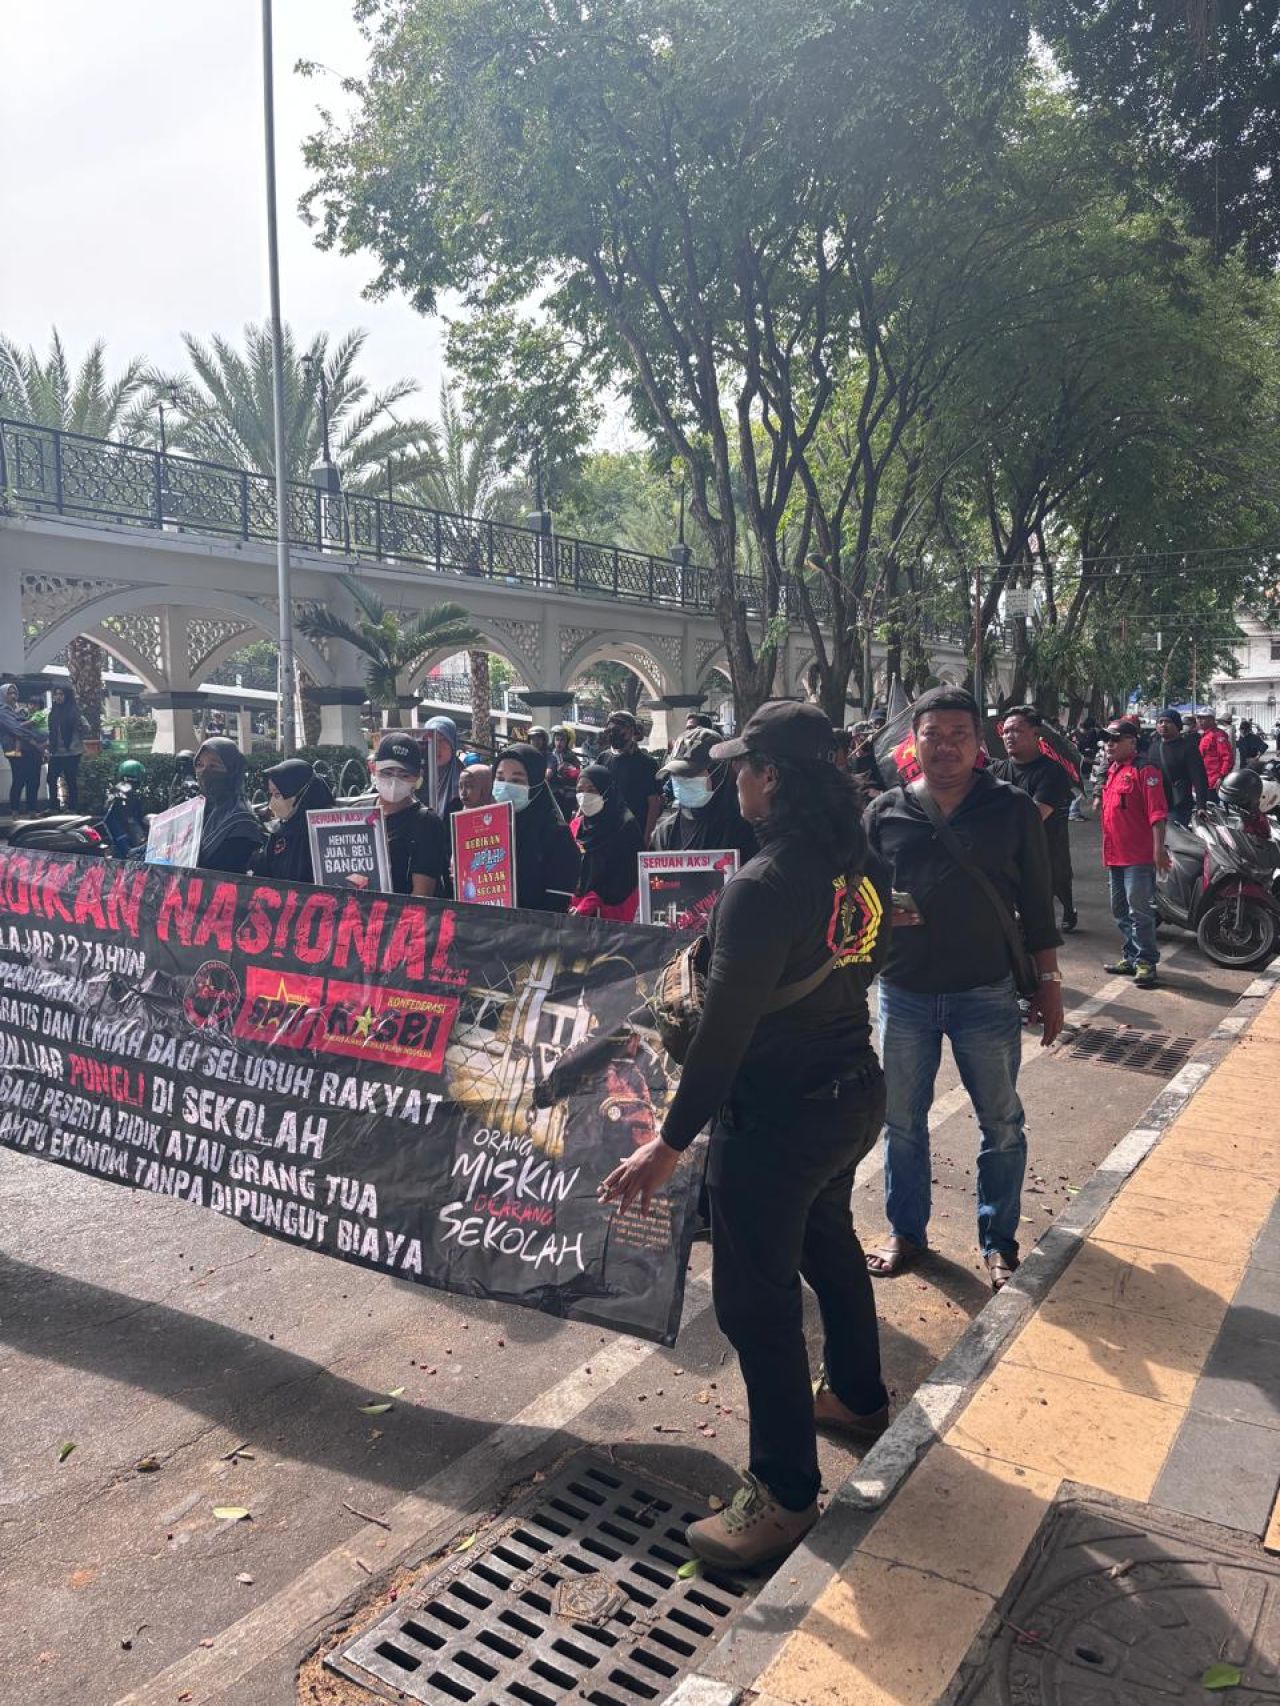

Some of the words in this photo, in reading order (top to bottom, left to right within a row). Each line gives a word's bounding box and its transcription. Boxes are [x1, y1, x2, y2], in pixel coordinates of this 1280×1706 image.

[324, 847, 350, 858] JUAL
[328, 833, 369, 846] HENTIKAN
[643, 856, 683, 868] SERUAN
[687, 856, 710, 867] AKSI
[324, 857, 374, 873] BANGKU
[60, 933, 80, 962] 12
[82, 941, 146, 978] TAHUN
[42, 1006, 76, 1043] DAN
[78, 1016, 147, 1057] ILMIAH
[148, 1036, 198, 1072] BAGI
[202, 1047, 313, 1100] SELURUH
[319, 1072, 443, 1125] RAKYAT
[151, 1076, 174, 1117] DI
[181, 1085, 329, 1159] SEKOLAH
[39, 1087, 112, 1138] PESERTA
[114, 1110, 161, 1153] DIDIK
[164, 1130, 226, 1173] ATAU
[228, 1149, 316, 1200] ORANG
[325, 1173, 378, 1219] TUA
[473, 1128, 534, 1157] ORANG
[451, 1151, 580, 1202] MISKIN
[135, 1156, 203, 1207] TANPA
[210, 1181, 329, 1243] DIPUNGUT
[336, 1218, 423, 1274] BIAYA
[438, 1201, 585, 1272] SEKOLAH
